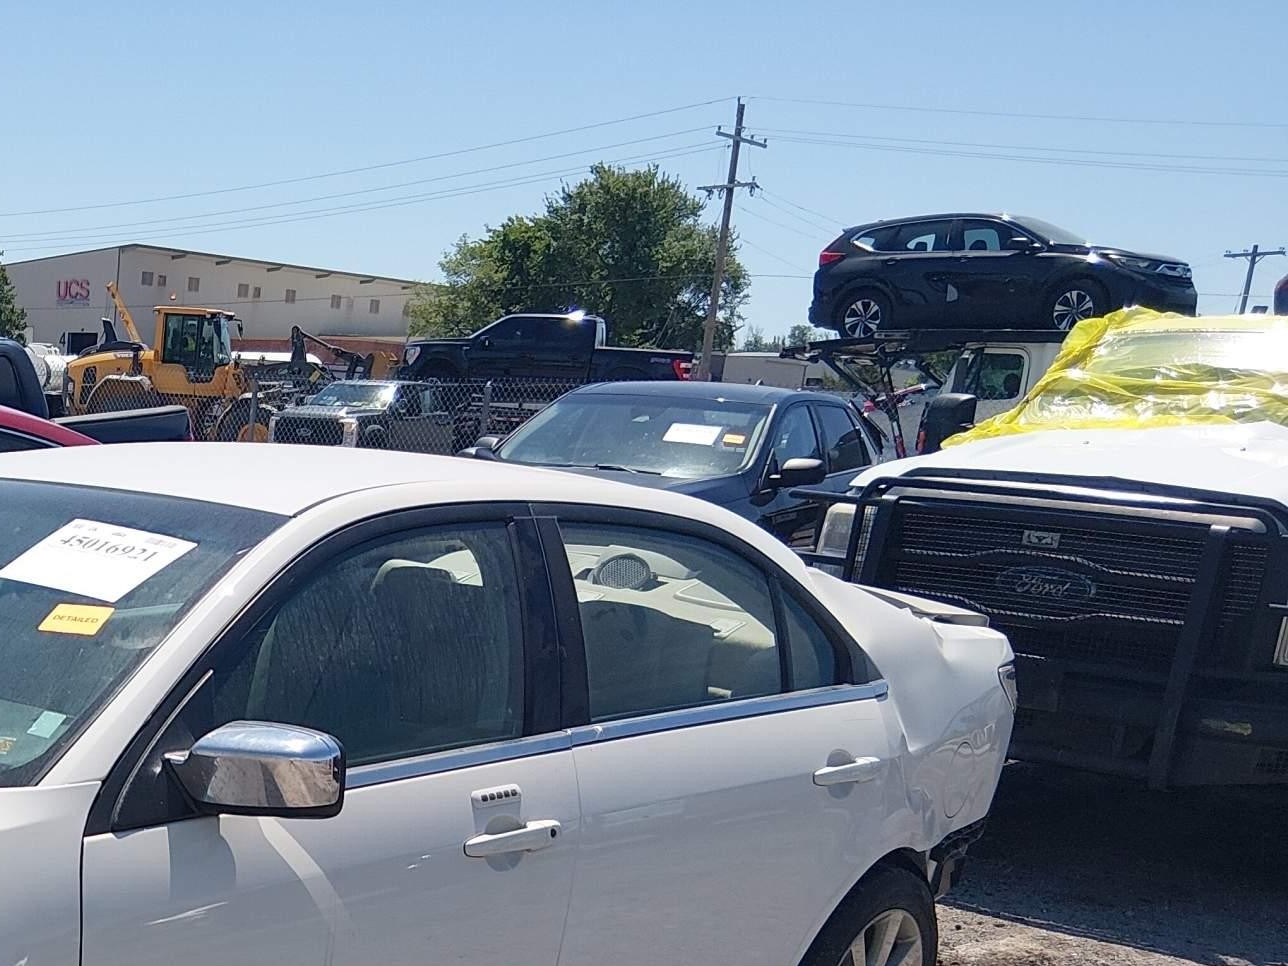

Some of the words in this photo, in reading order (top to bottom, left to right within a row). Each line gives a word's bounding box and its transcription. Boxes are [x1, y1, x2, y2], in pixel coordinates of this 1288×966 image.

[57, 279, 90, 300] UCS
[60, 534, 159, 562] 45016921
[1015, 574, 1072, 597] Ford
[53, 614, 99, 624] DETAILED
